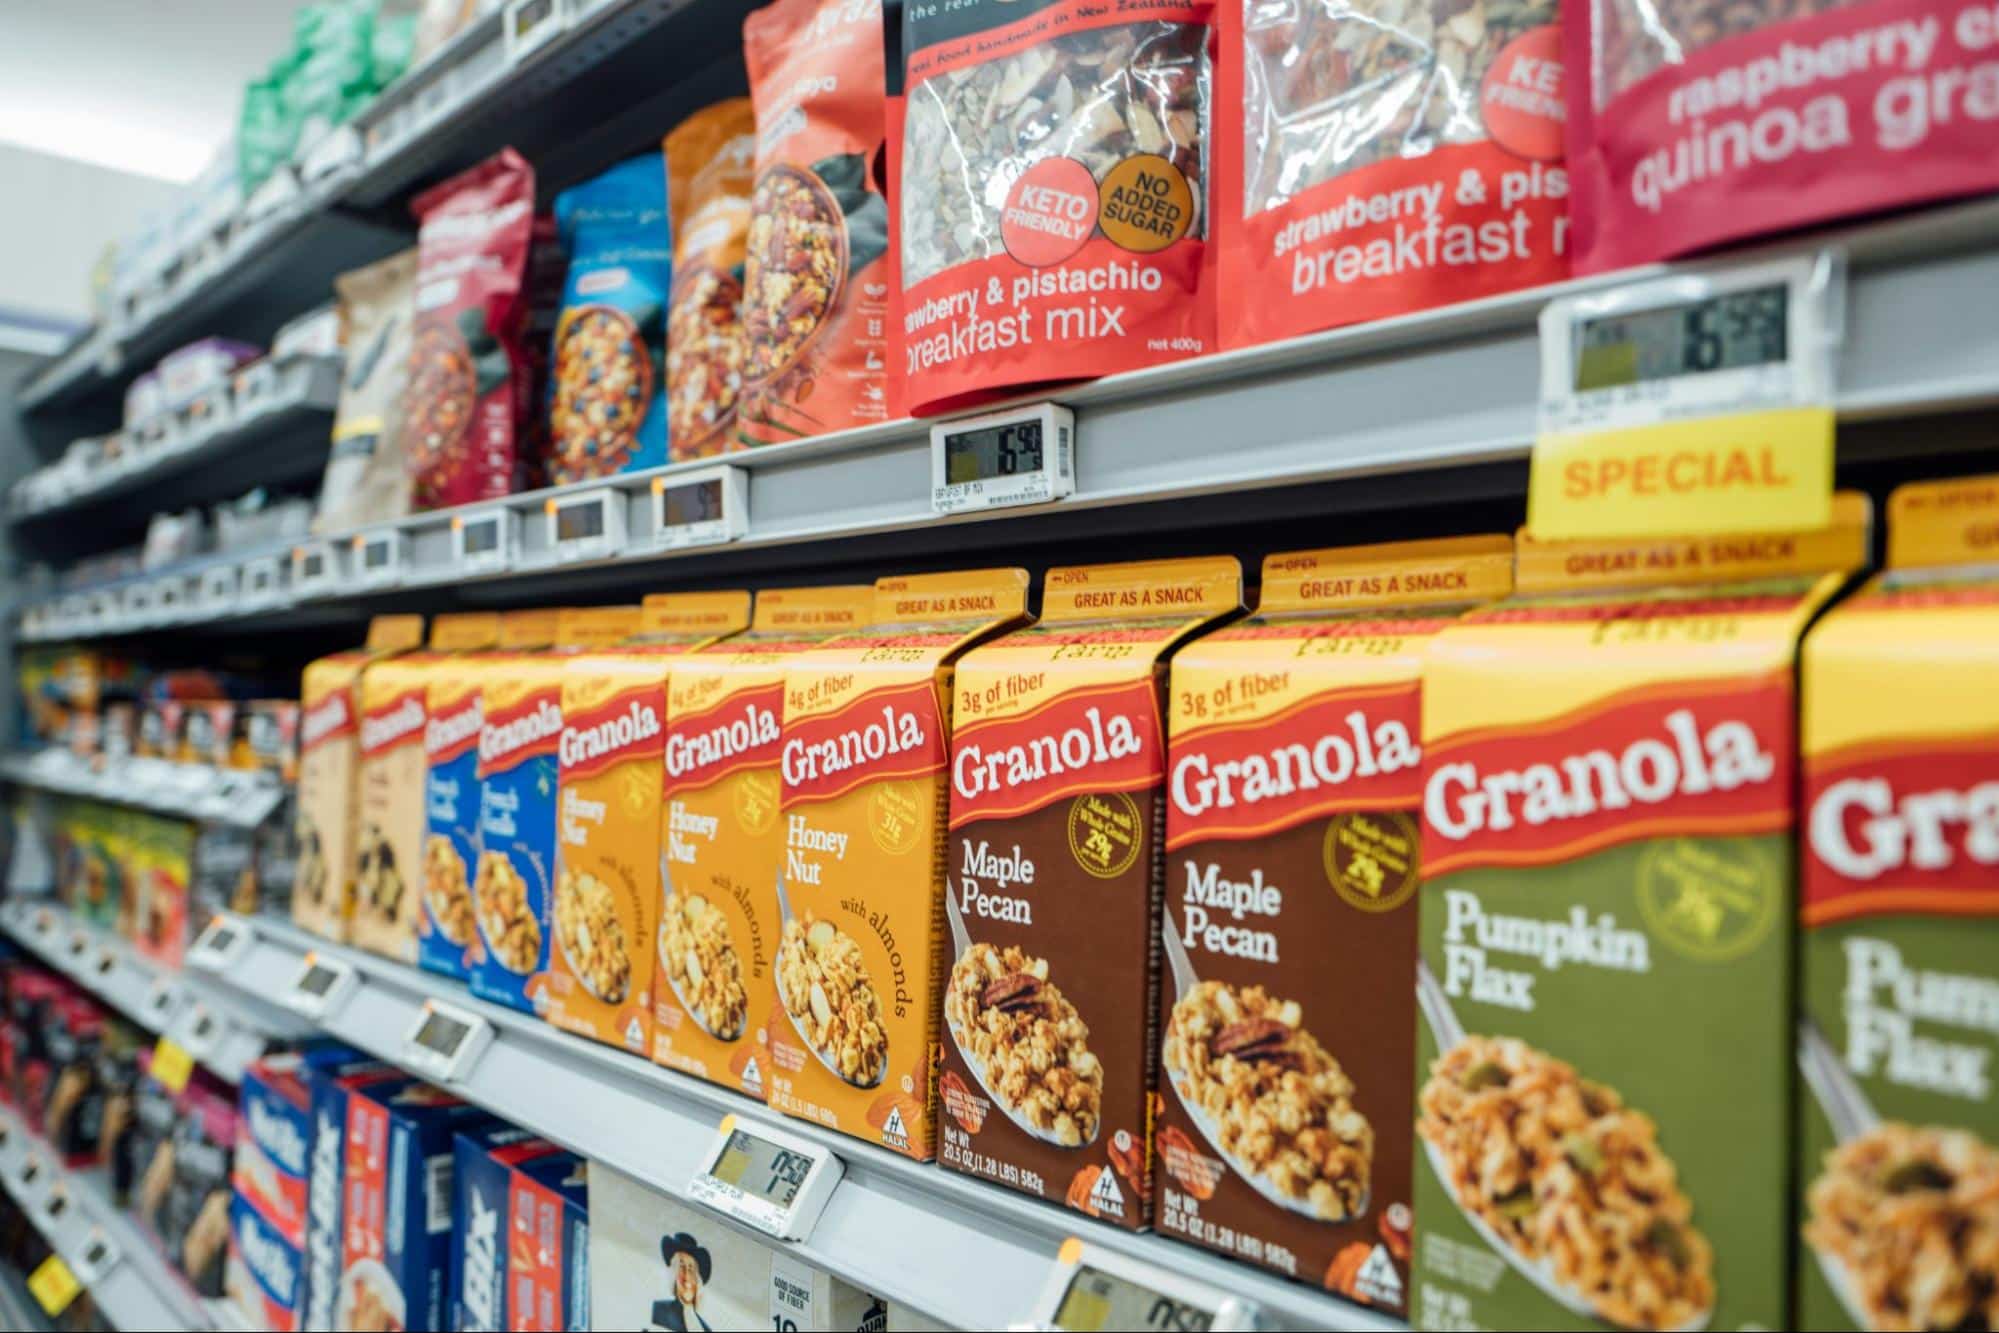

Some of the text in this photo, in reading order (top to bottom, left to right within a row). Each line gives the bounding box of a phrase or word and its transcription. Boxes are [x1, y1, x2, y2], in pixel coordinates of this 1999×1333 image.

[1669, 15, 1940, 124] raspberry
[1632, 94, 1851, 212] quinoa
[1018, 185, 1089, 221] KETO
[1110, 184, 1181, 221] ADDED
[1135, 170, 1171, 196] NO
[1004, 206, 1087, 240] FRIENDLY
[1103, 202, 1176, 239] SUGAR
[1273, 181, 1444, 256] strawberry
[1455, 168, 1487, 205] &
[1292, 208, 1531, 294] breakfast
[986, 276, 1004, 305] &
[1013, 260, 1162, 306] pistachio
[1046, 297, 1126, 341] mix
[1147, 338, 1203, 352] net 400g
[1563, 446, 1790, 500] SPECIAL
[896, 596, 997, 614] GREAT AS A SNACK
[1074, 586, 1204, 609] GREAT AS A SNACK
[1300, 571, 1468, 600] GREAT AS A SNACK
[789, 673, 855, 710] 4g of fiber
[961, 691, 982, 714] 3g
[986, 679, 1002, 704] of
[1006, 672, 1046, 697] fiber
[1181, 692, 1208, 718] 3g
[1213, 679, 1234, 706] of
[1240, 671, 1290, 700] fiber
[479, 699, 562, 761] Granola
[559, 700, 661, 768] Granola
[665, 704, 780, 777] Granola
[782, 705, 925, 786] Granola
[953, 707, 1142, 799] Granola
[1171, 711, 1422, 816] Granola
[1423, 709, 1774, 840] Granola
[669, 800, 719, 840] Honey
[787, 814, 849, 859] Honey
[667, 831, 697, 864] Nut
[785, 848, 822, 885] Nut
[960, 838, 1035, 888] Maple
[960, 877, 1033, 925] Pecan
[1182, 859, 1282, 920] Maple
[732, 885, 769, 979] almonds
[1182, 905, 1280, 963] Pecan
[1442, 888, 1651, 972] Pumpkin
[840, 896, 914, 1019] with almonds
[1442, 943, 1536, 1010] Flax
[890, 1115, 901, 1132] H
[944, 1124, 970, 1149] Net Wt
[943, 1141, 961, 1164] 20.5
[1020, 1168, 1046, 1196] 582g
[1100, 1177, 1113, 1196] H
[1089, 1195, 1124, 1218] HALAL
[786, 1294, 805, 1311] FIBER
[788, 1282, 811, 1303] SOURCE
